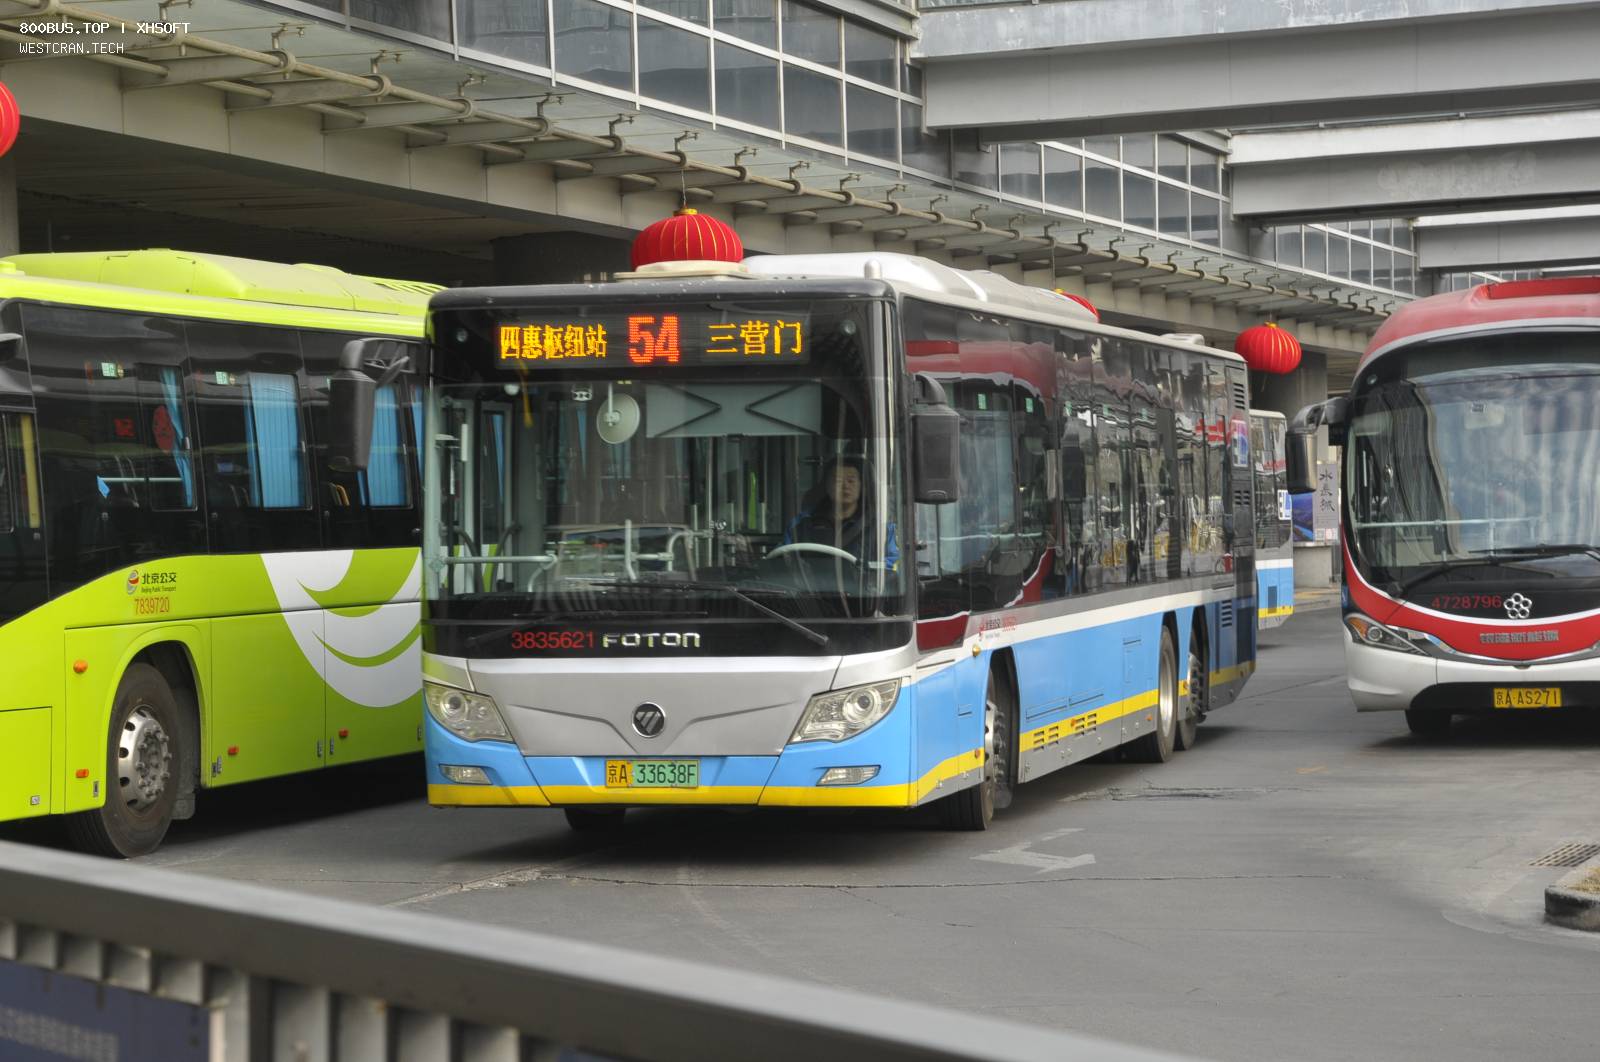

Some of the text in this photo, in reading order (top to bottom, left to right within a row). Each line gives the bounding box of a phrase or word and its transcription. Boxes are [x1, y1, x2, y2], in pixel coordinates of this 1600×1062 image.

[500, 324, 607, 359] 四惠枢纽站
[628, 315, 679, 363] 54
[706, 319, 803, 354] 三营门
[141, 573, 176, 584] 北京公交
[134, 597, 170, 614] 7839720
[1431, 595, 1502, 609] 4728796
[511, 632, 594, 649] 3835621
